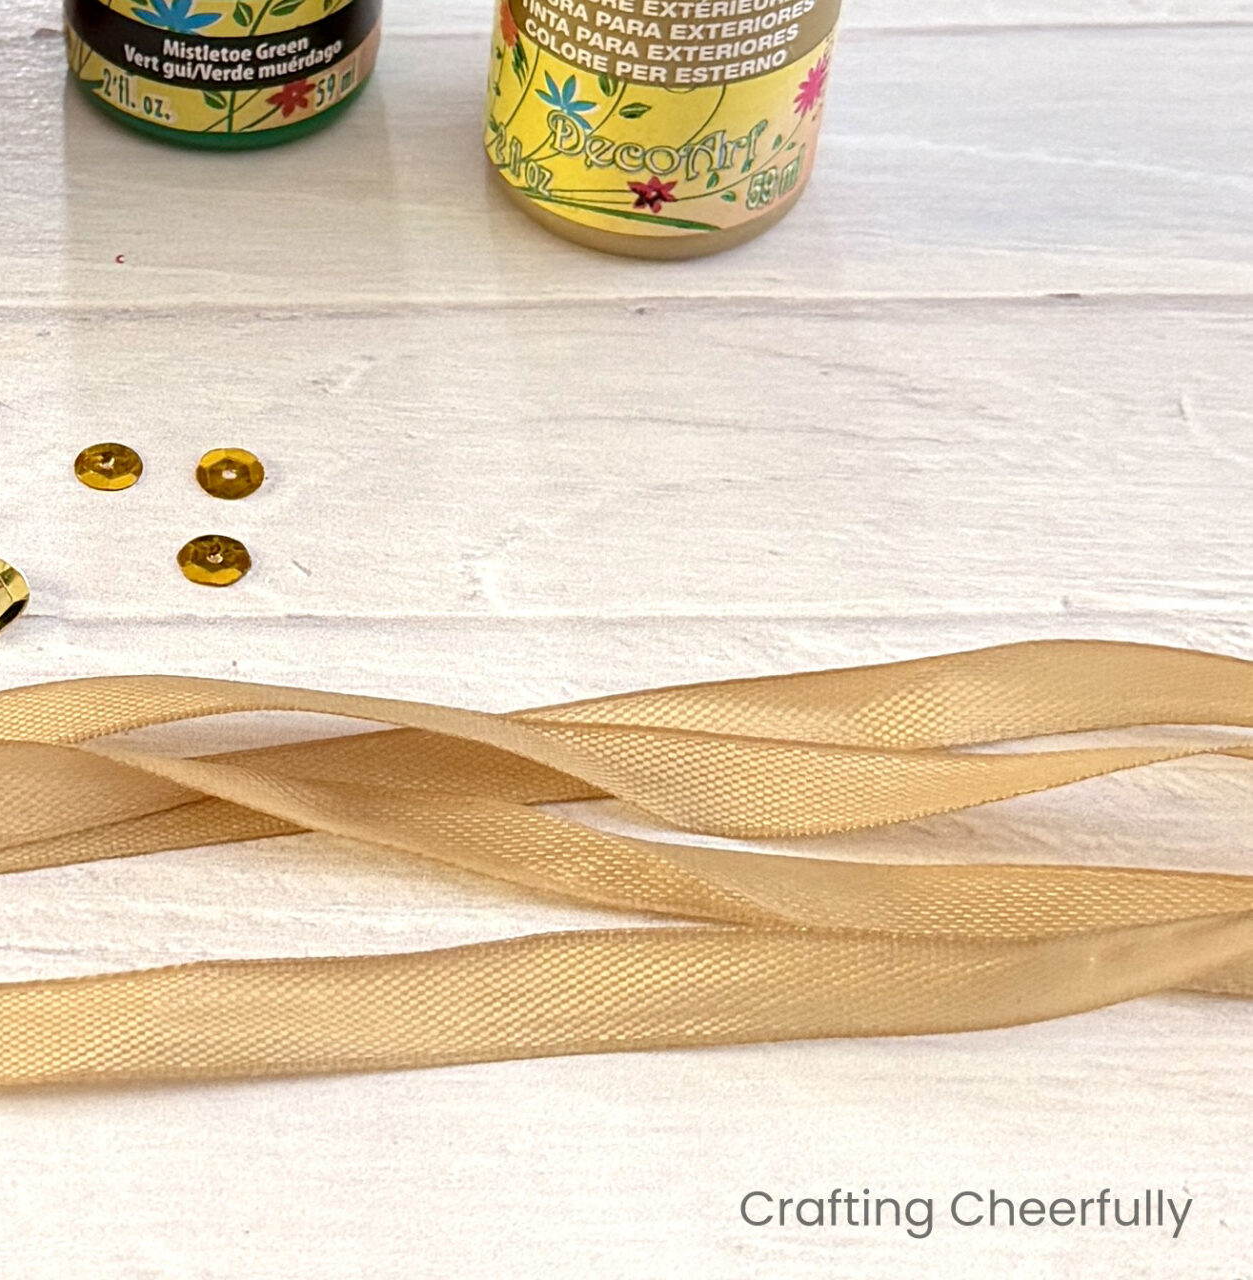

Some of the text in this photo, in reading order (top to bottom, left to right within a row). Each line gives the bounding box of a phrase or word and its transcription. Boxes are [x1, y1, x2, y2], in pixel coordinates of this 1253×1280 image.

[576, 27, 641, 59] PARA
[648, 23, 799, 62] EXTERIORES
[596, 11, 663, 41] PARA
[123, 39, 343, 83] Vert gui/Verde muérdago
[162, 35, 309, 64] Mistletoe Green
[525, 19, 788, 84] COLORE PER ESTERNO
[143, 96, 171, 120] oz.
[315, 73, 336, 109] 59
[546, 109, 769, 181] DecoArt
[746, 163, 777, 210] 59
